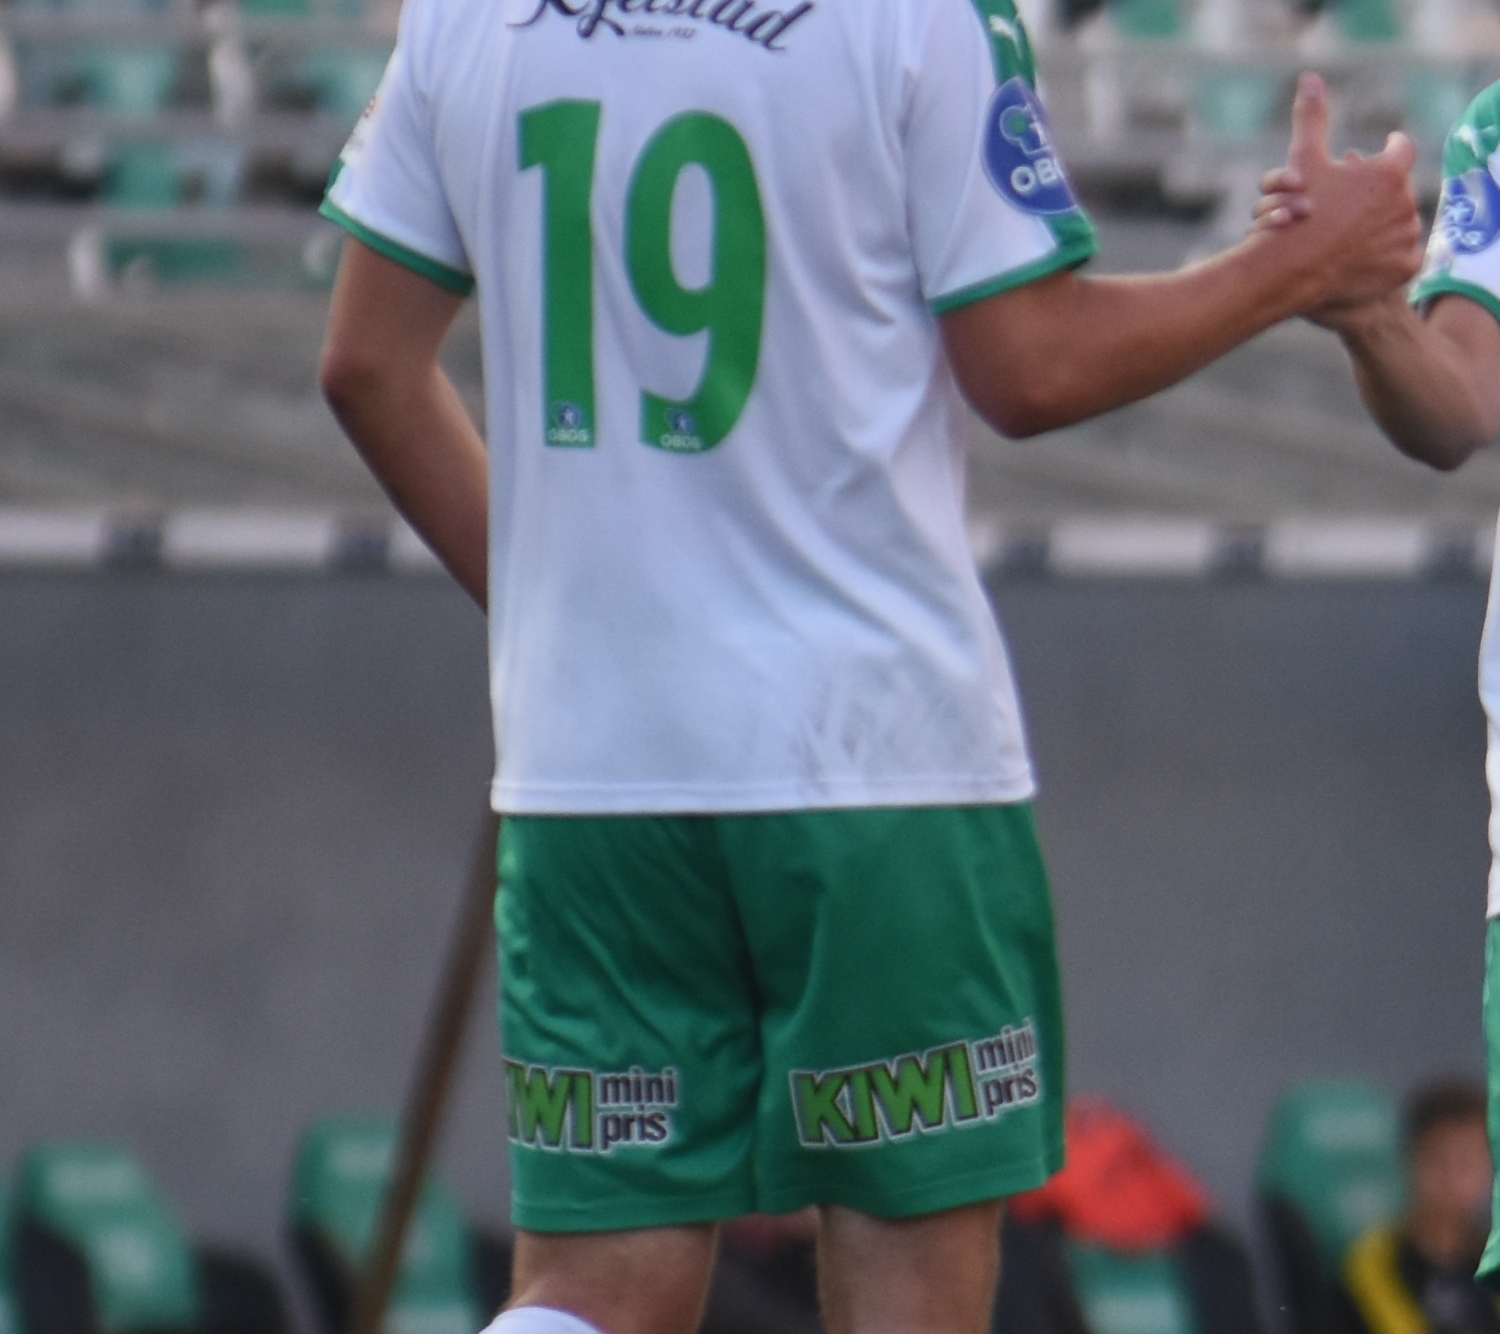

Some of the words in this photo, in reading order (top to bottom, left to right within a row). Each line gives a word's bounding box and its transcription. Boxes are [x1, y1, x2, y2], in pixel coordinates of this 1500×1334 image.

[1010, 157, 1065, 192] OB
[517, 98, 766, 454] 19
[976, 1019, 1036, 1072] mini
[502, 1058, 593, 1150] IWI
[600, 1067, 677, 1104] mini
[793, 1043, 978, 1145] KIWI
[984, 1066, 1038, 1118] pris
[600, 1105, 667, 1152] pris
